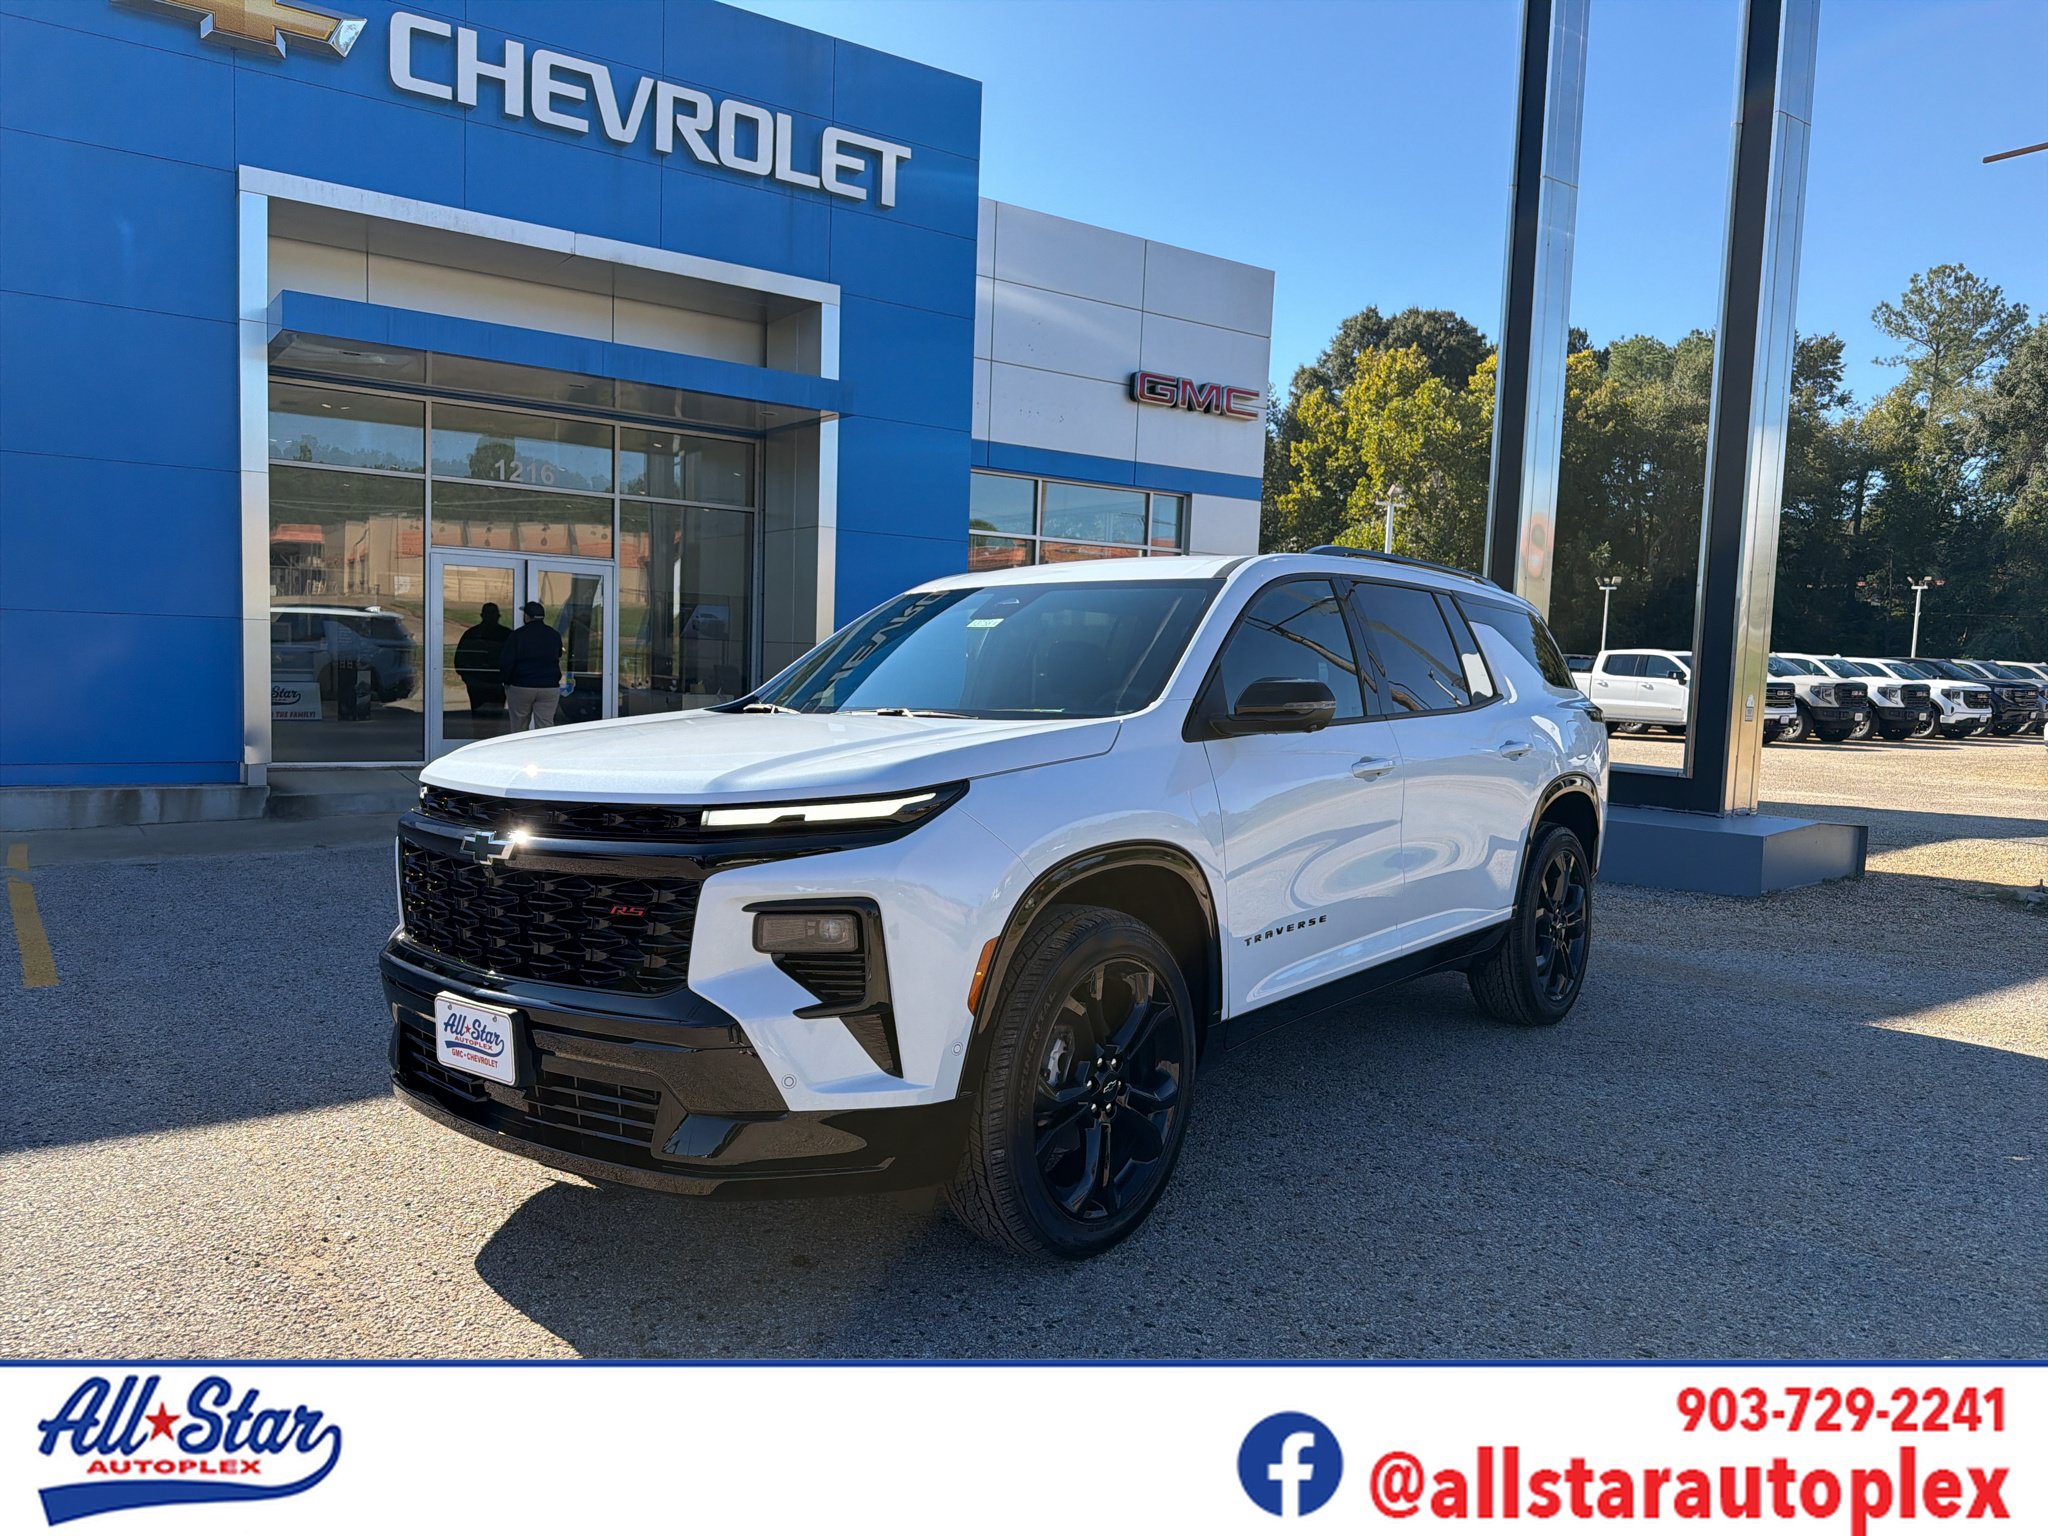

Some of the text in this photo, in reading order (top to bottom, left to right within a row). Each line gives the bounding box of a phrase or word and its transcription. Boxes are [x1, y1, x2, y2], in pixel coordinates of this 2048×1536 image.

[389, 11, 912, 208] CHEVROLET
[1130, 370, 1260, 420] GMC
[494, 459, 555, 485] 1216
[272, 685, 299, 699] Star
[610, 904, 646, 917] RS
[1244, 914, 1327, 947] TRAVERSE
[443, 1012, 502, 1047] All Star
[454, 1035, 494, 1051] AUTOPLEX
[451, 1048, 499, 1069] GMC CHEVROLET
